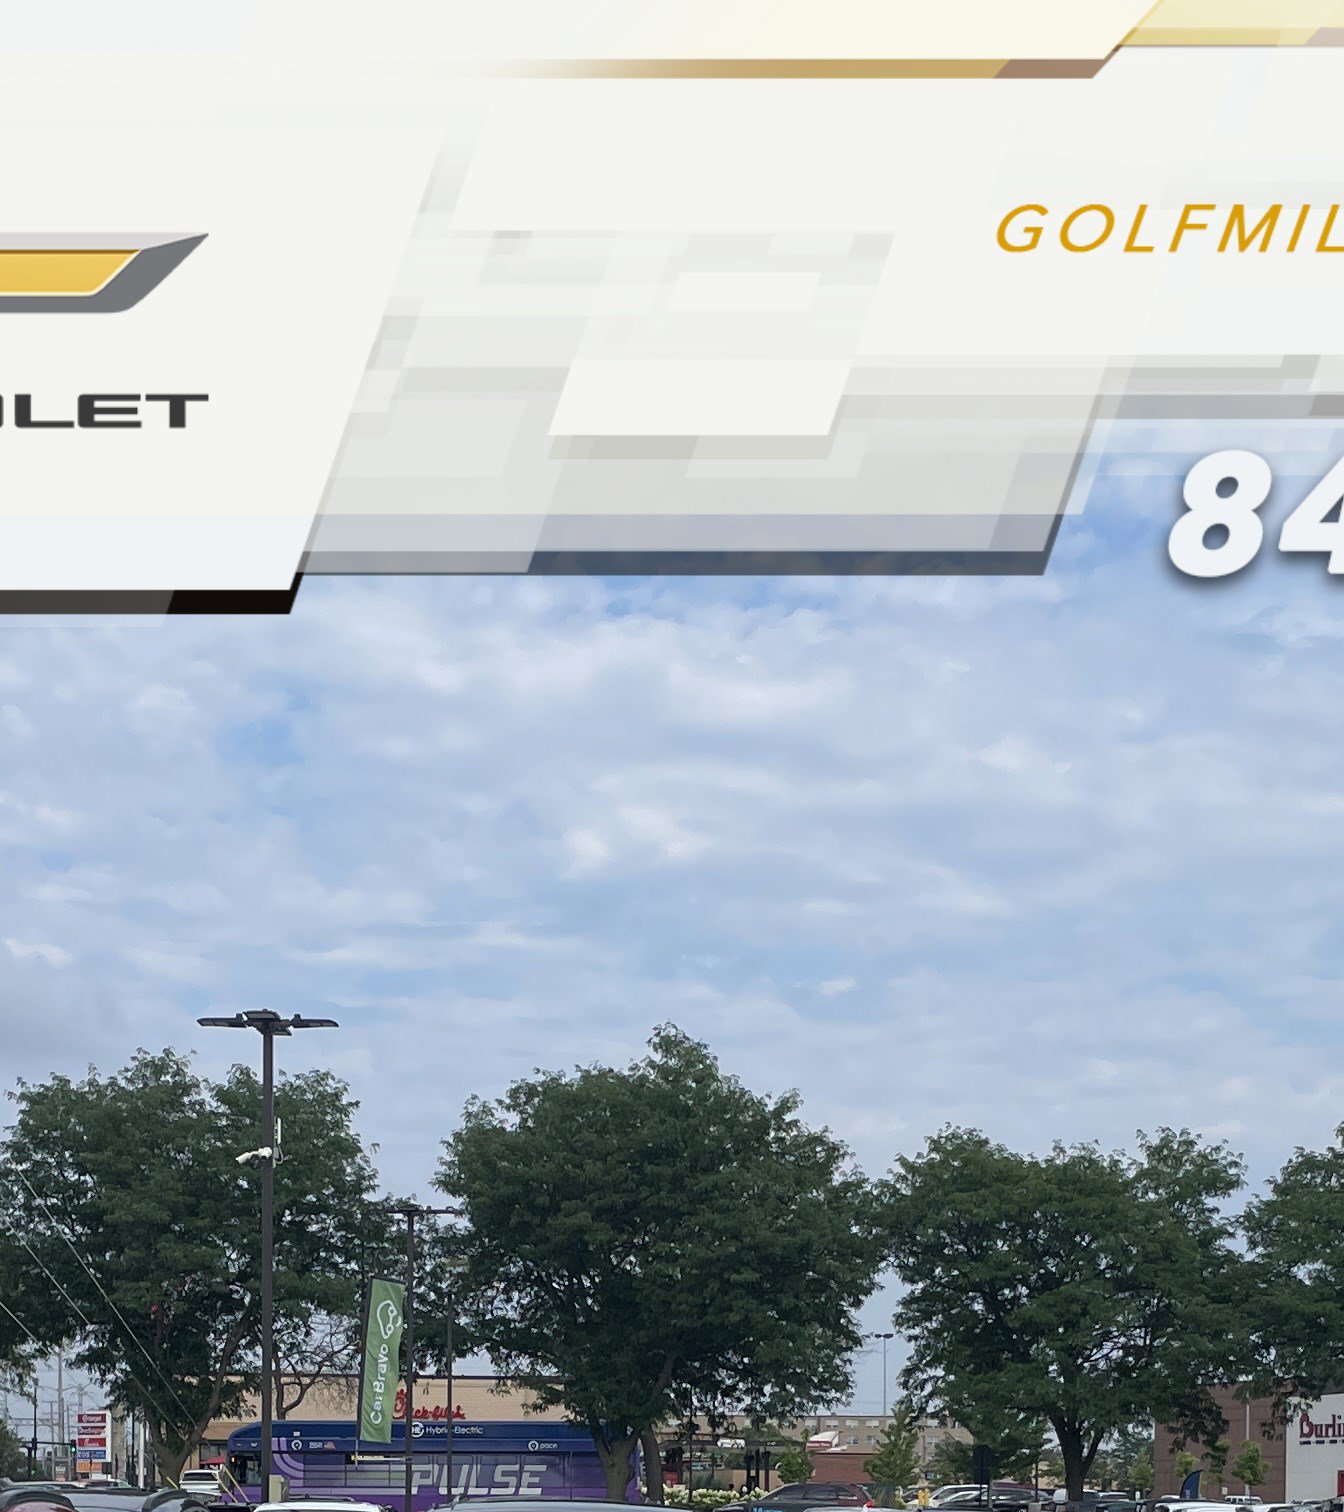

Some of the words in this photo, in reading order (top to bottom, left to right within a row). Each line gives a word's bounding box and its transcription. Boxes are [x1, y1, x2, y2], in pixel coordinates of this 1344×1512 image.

[369, 1343, 389, 1425] CarBravo
[425, 1425, 484, 1437] Hybri-Electric
[411, 1464, 548, 1496] PULSE
